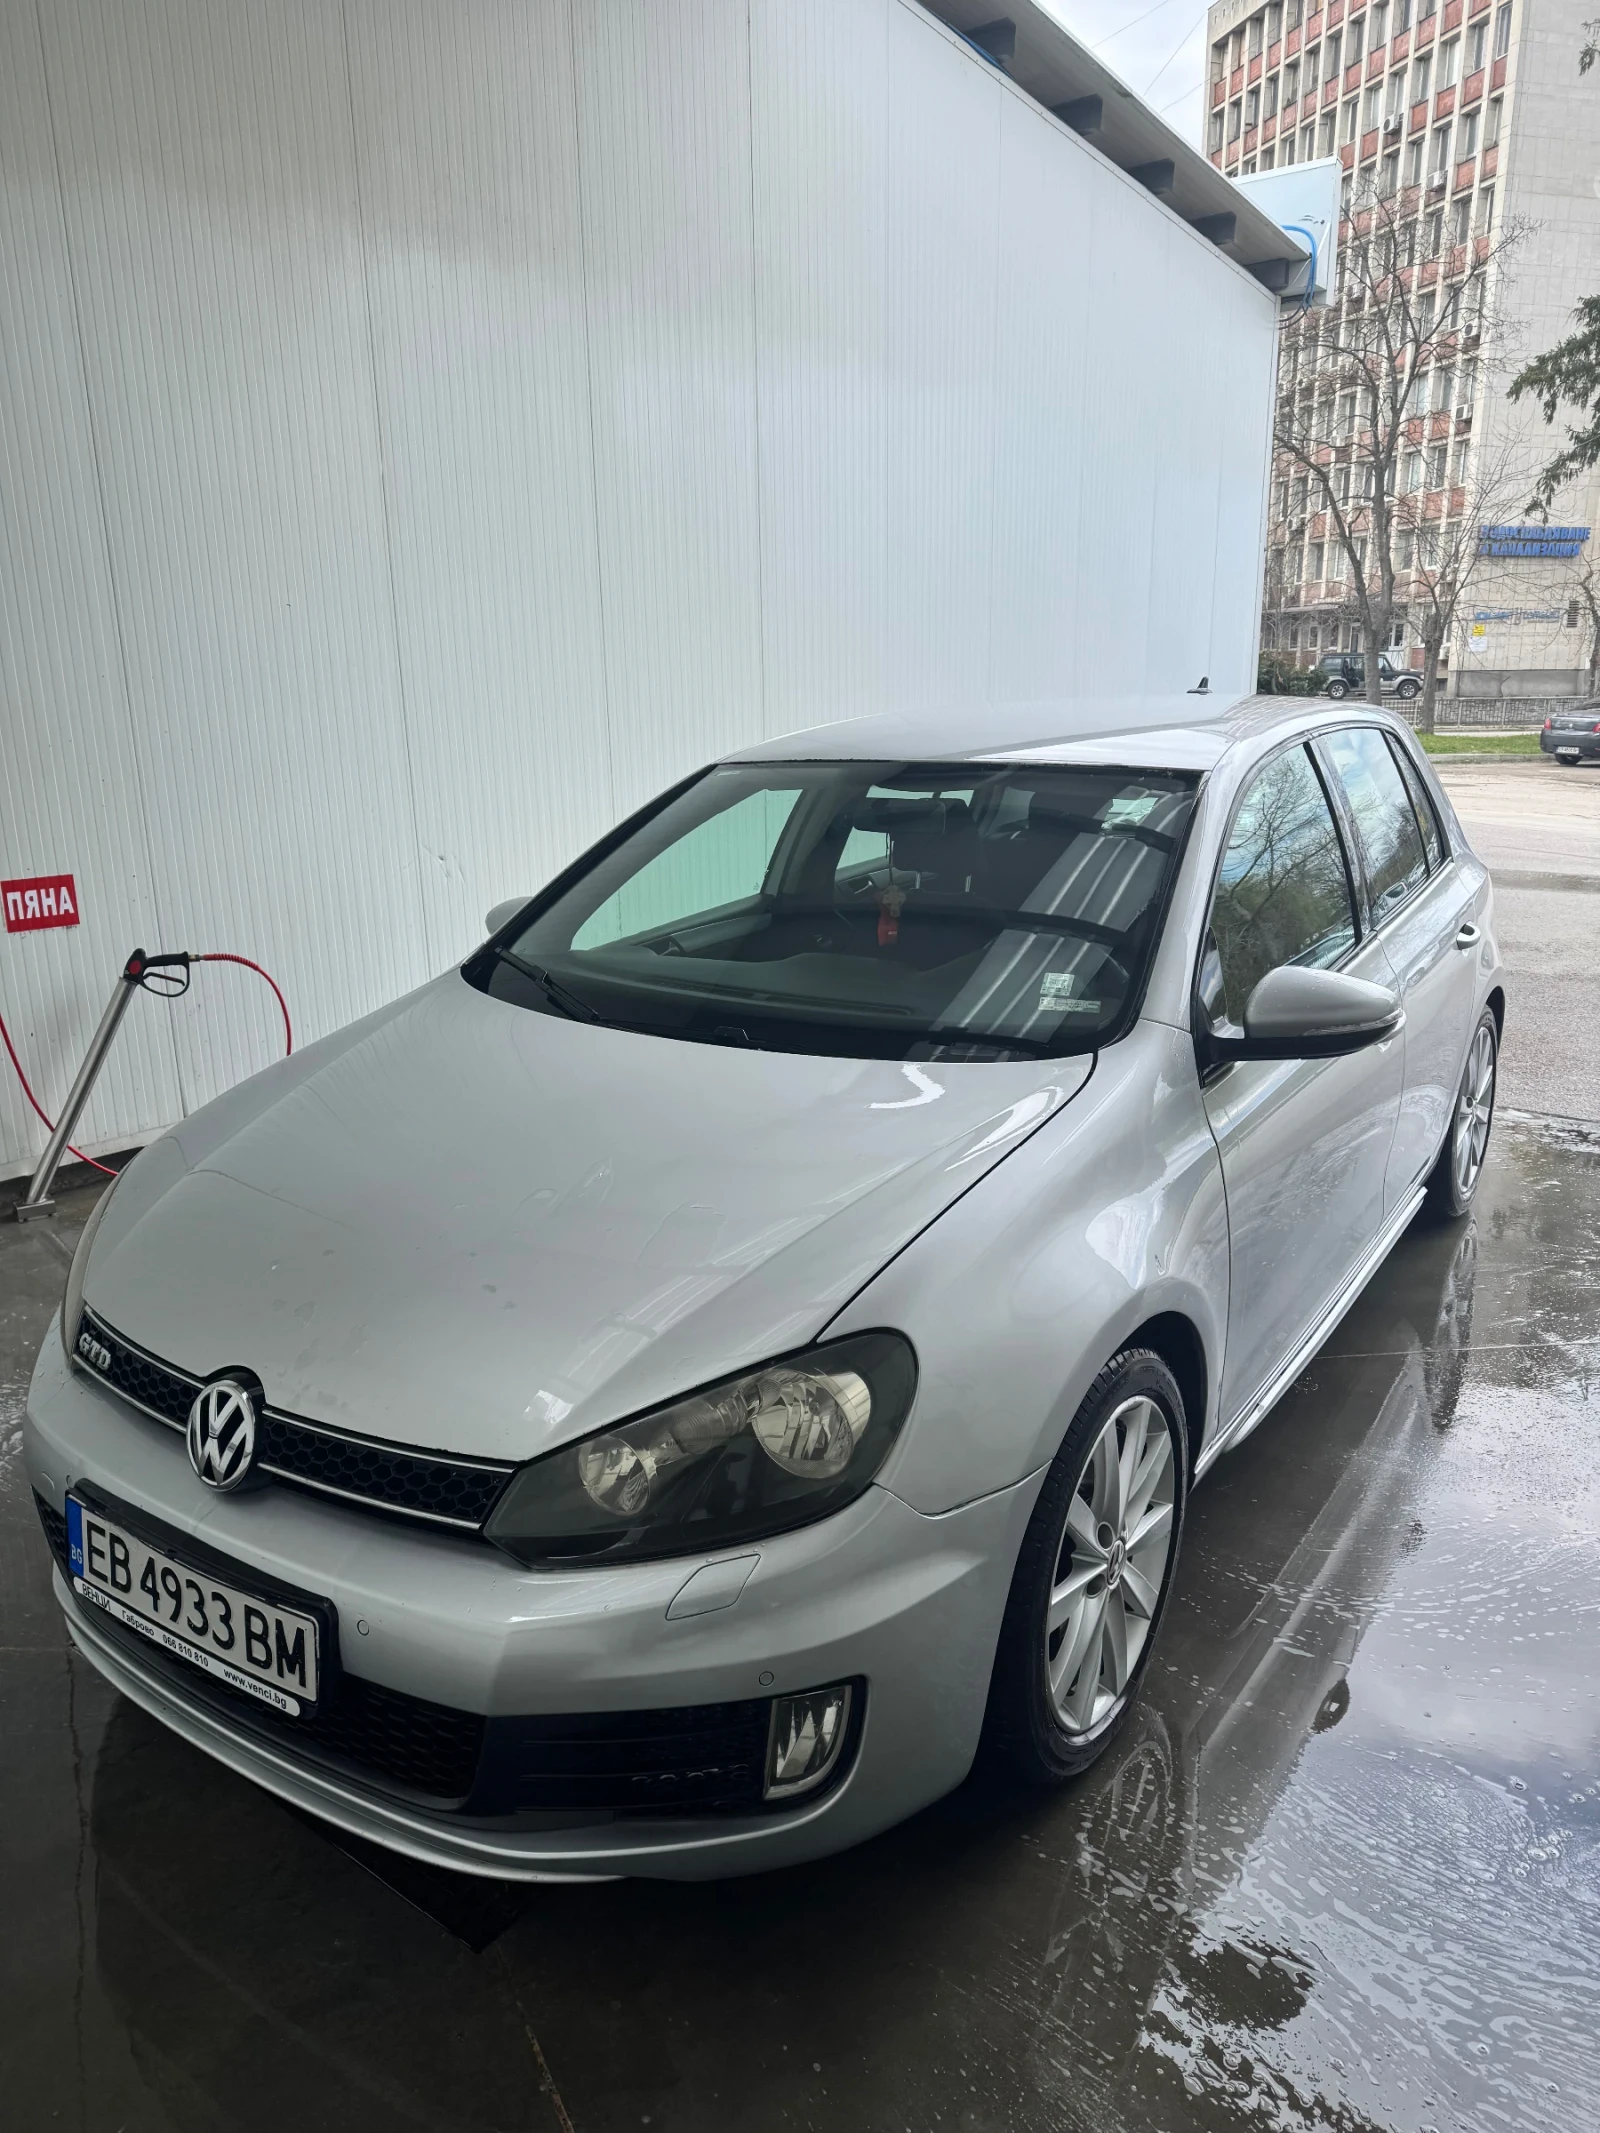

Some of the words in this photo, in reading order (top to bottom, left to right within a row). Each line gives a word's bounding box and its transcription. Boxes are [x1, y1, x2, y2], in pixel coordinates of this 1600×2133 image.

[6, 886, 75, 921] ПЯНА
[79, 1332, 112, 1370] GTD
[71, 1544, 83, 1565] BG
[86, 1519, 131, 1594] EB
[140, 1556, 235, 1650] 4933
[244, 1603, 307, 1688] BM
[82, 1583, 111, 1612] ВЕНЦИ
[122, 1610, 155, 1637] Габрово
[178, 1643, 193, 1659] 810
[194, 1651, 209, 1667] 810
[223, 1669, 287, 1710] www.venci.bg
